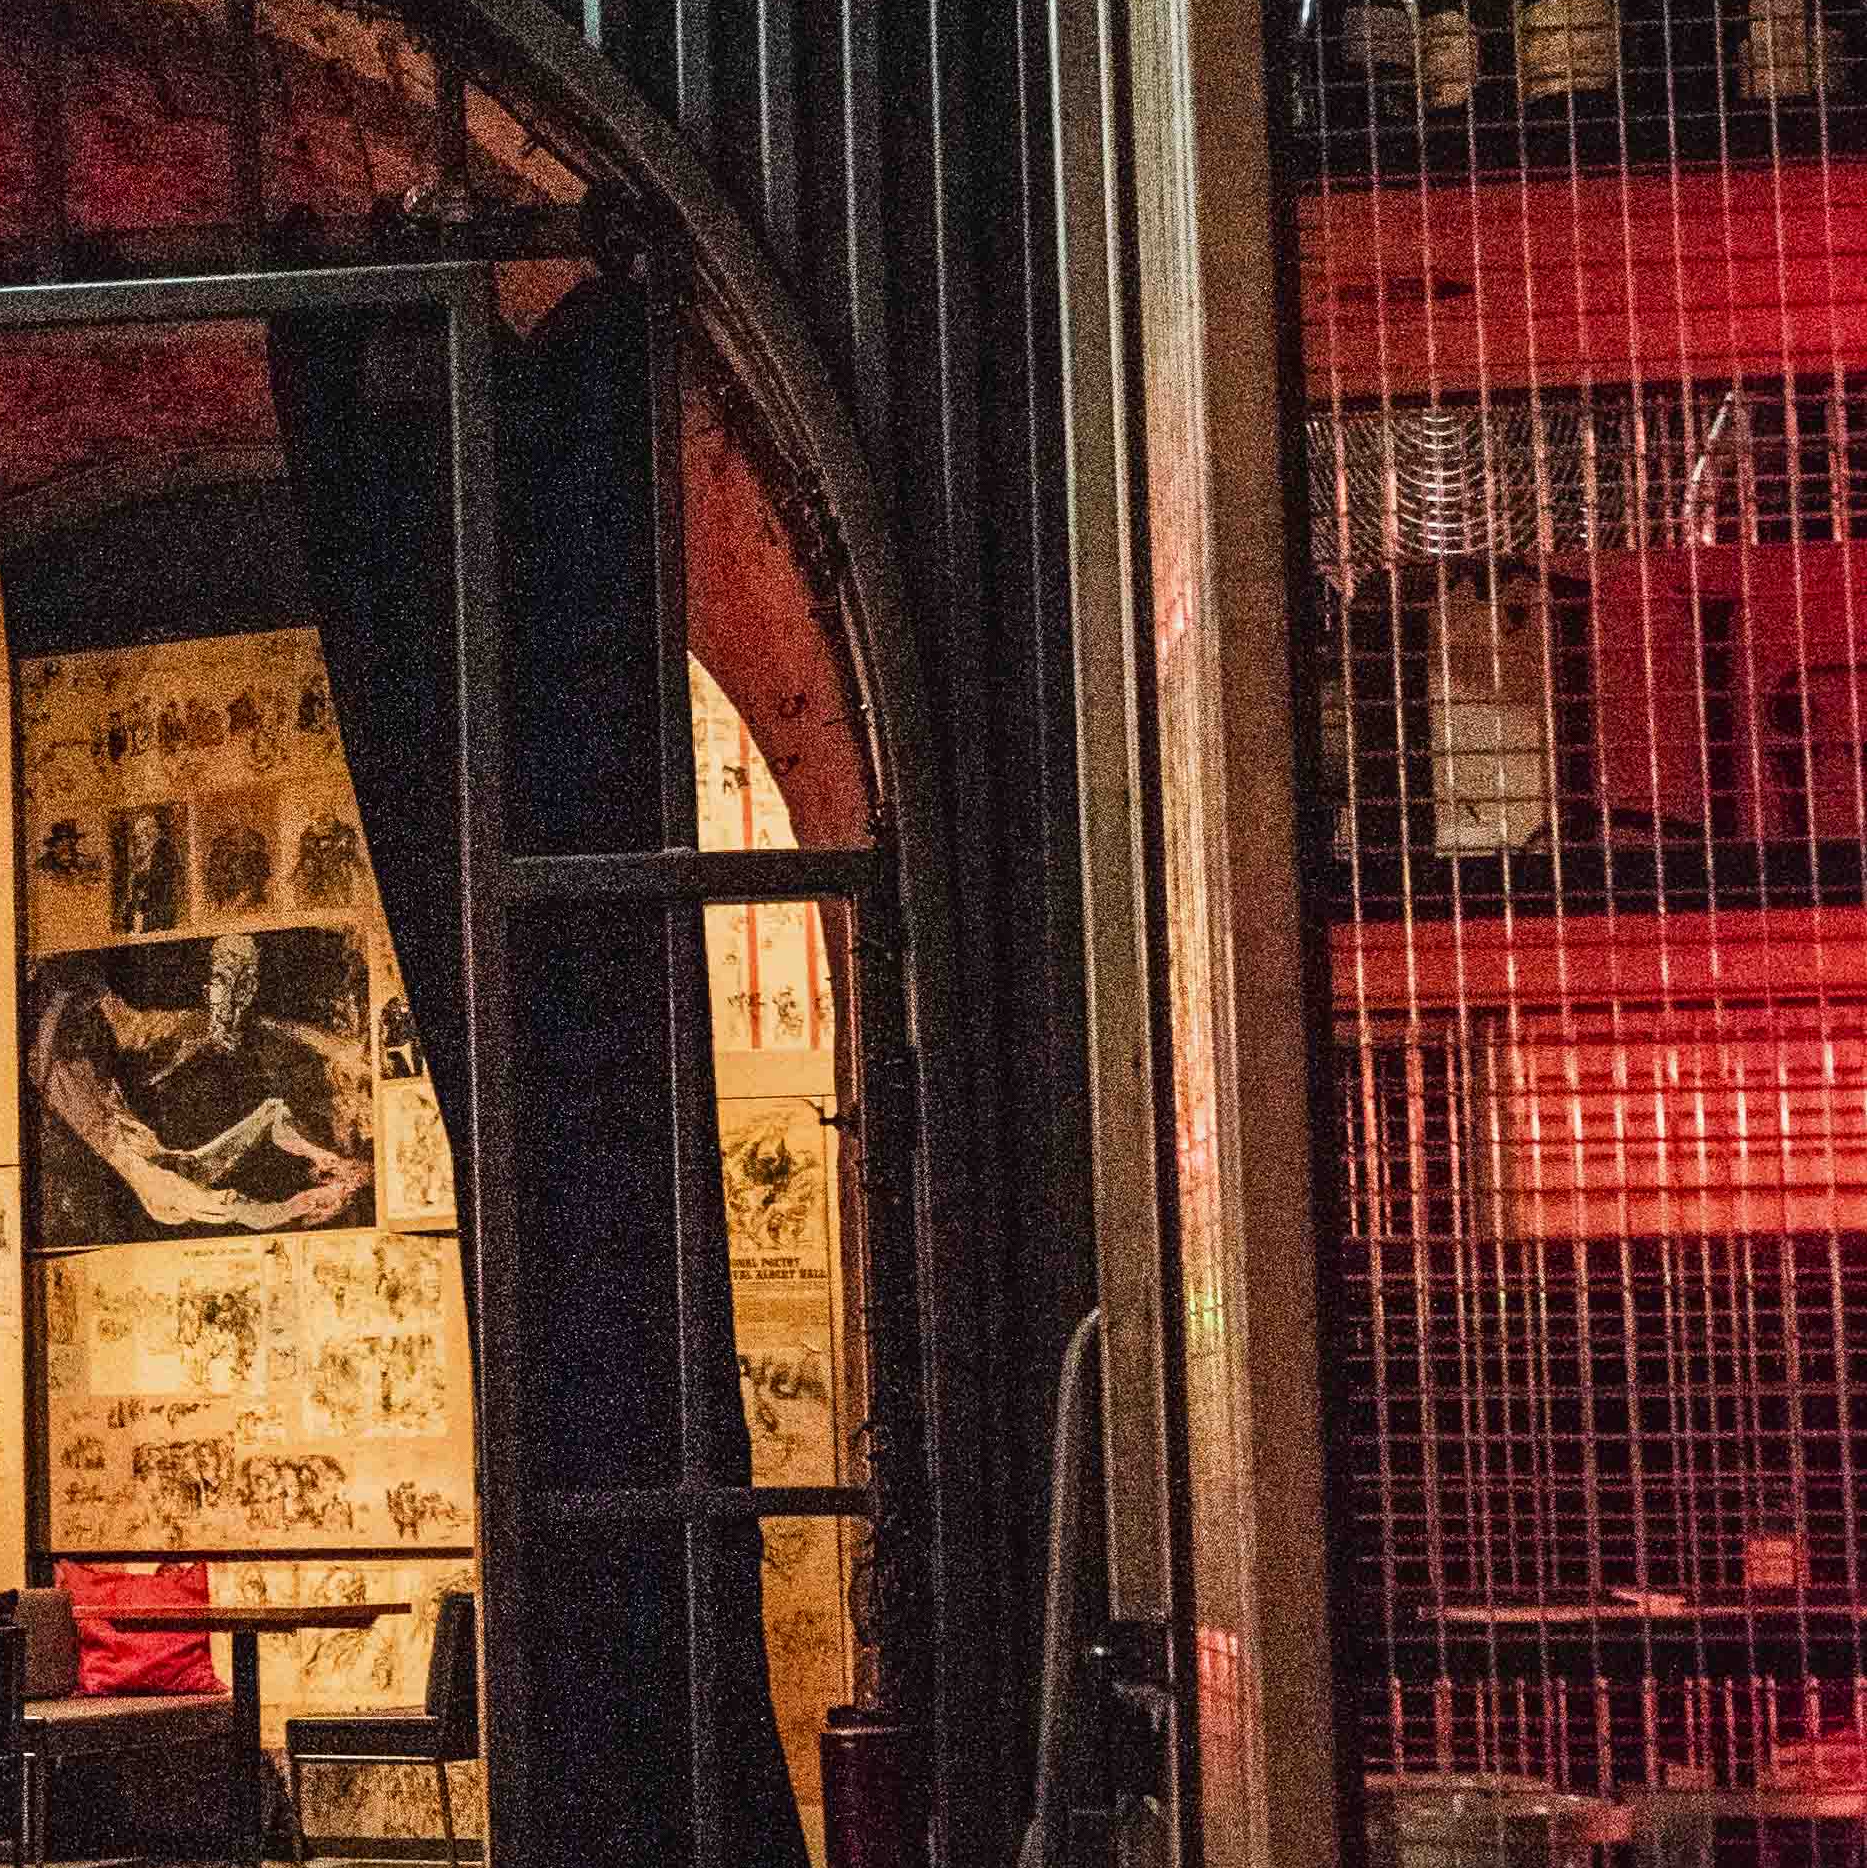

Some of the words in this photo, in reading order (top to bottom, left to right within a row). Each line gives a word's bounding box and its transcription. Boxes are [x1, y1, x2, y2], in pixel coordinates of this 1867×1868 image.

[761, 1257, 800, 1268] POETRY
[755, 1269, 796, 1279] ALBERT
[799, 1268, 828, 1279] HALL
